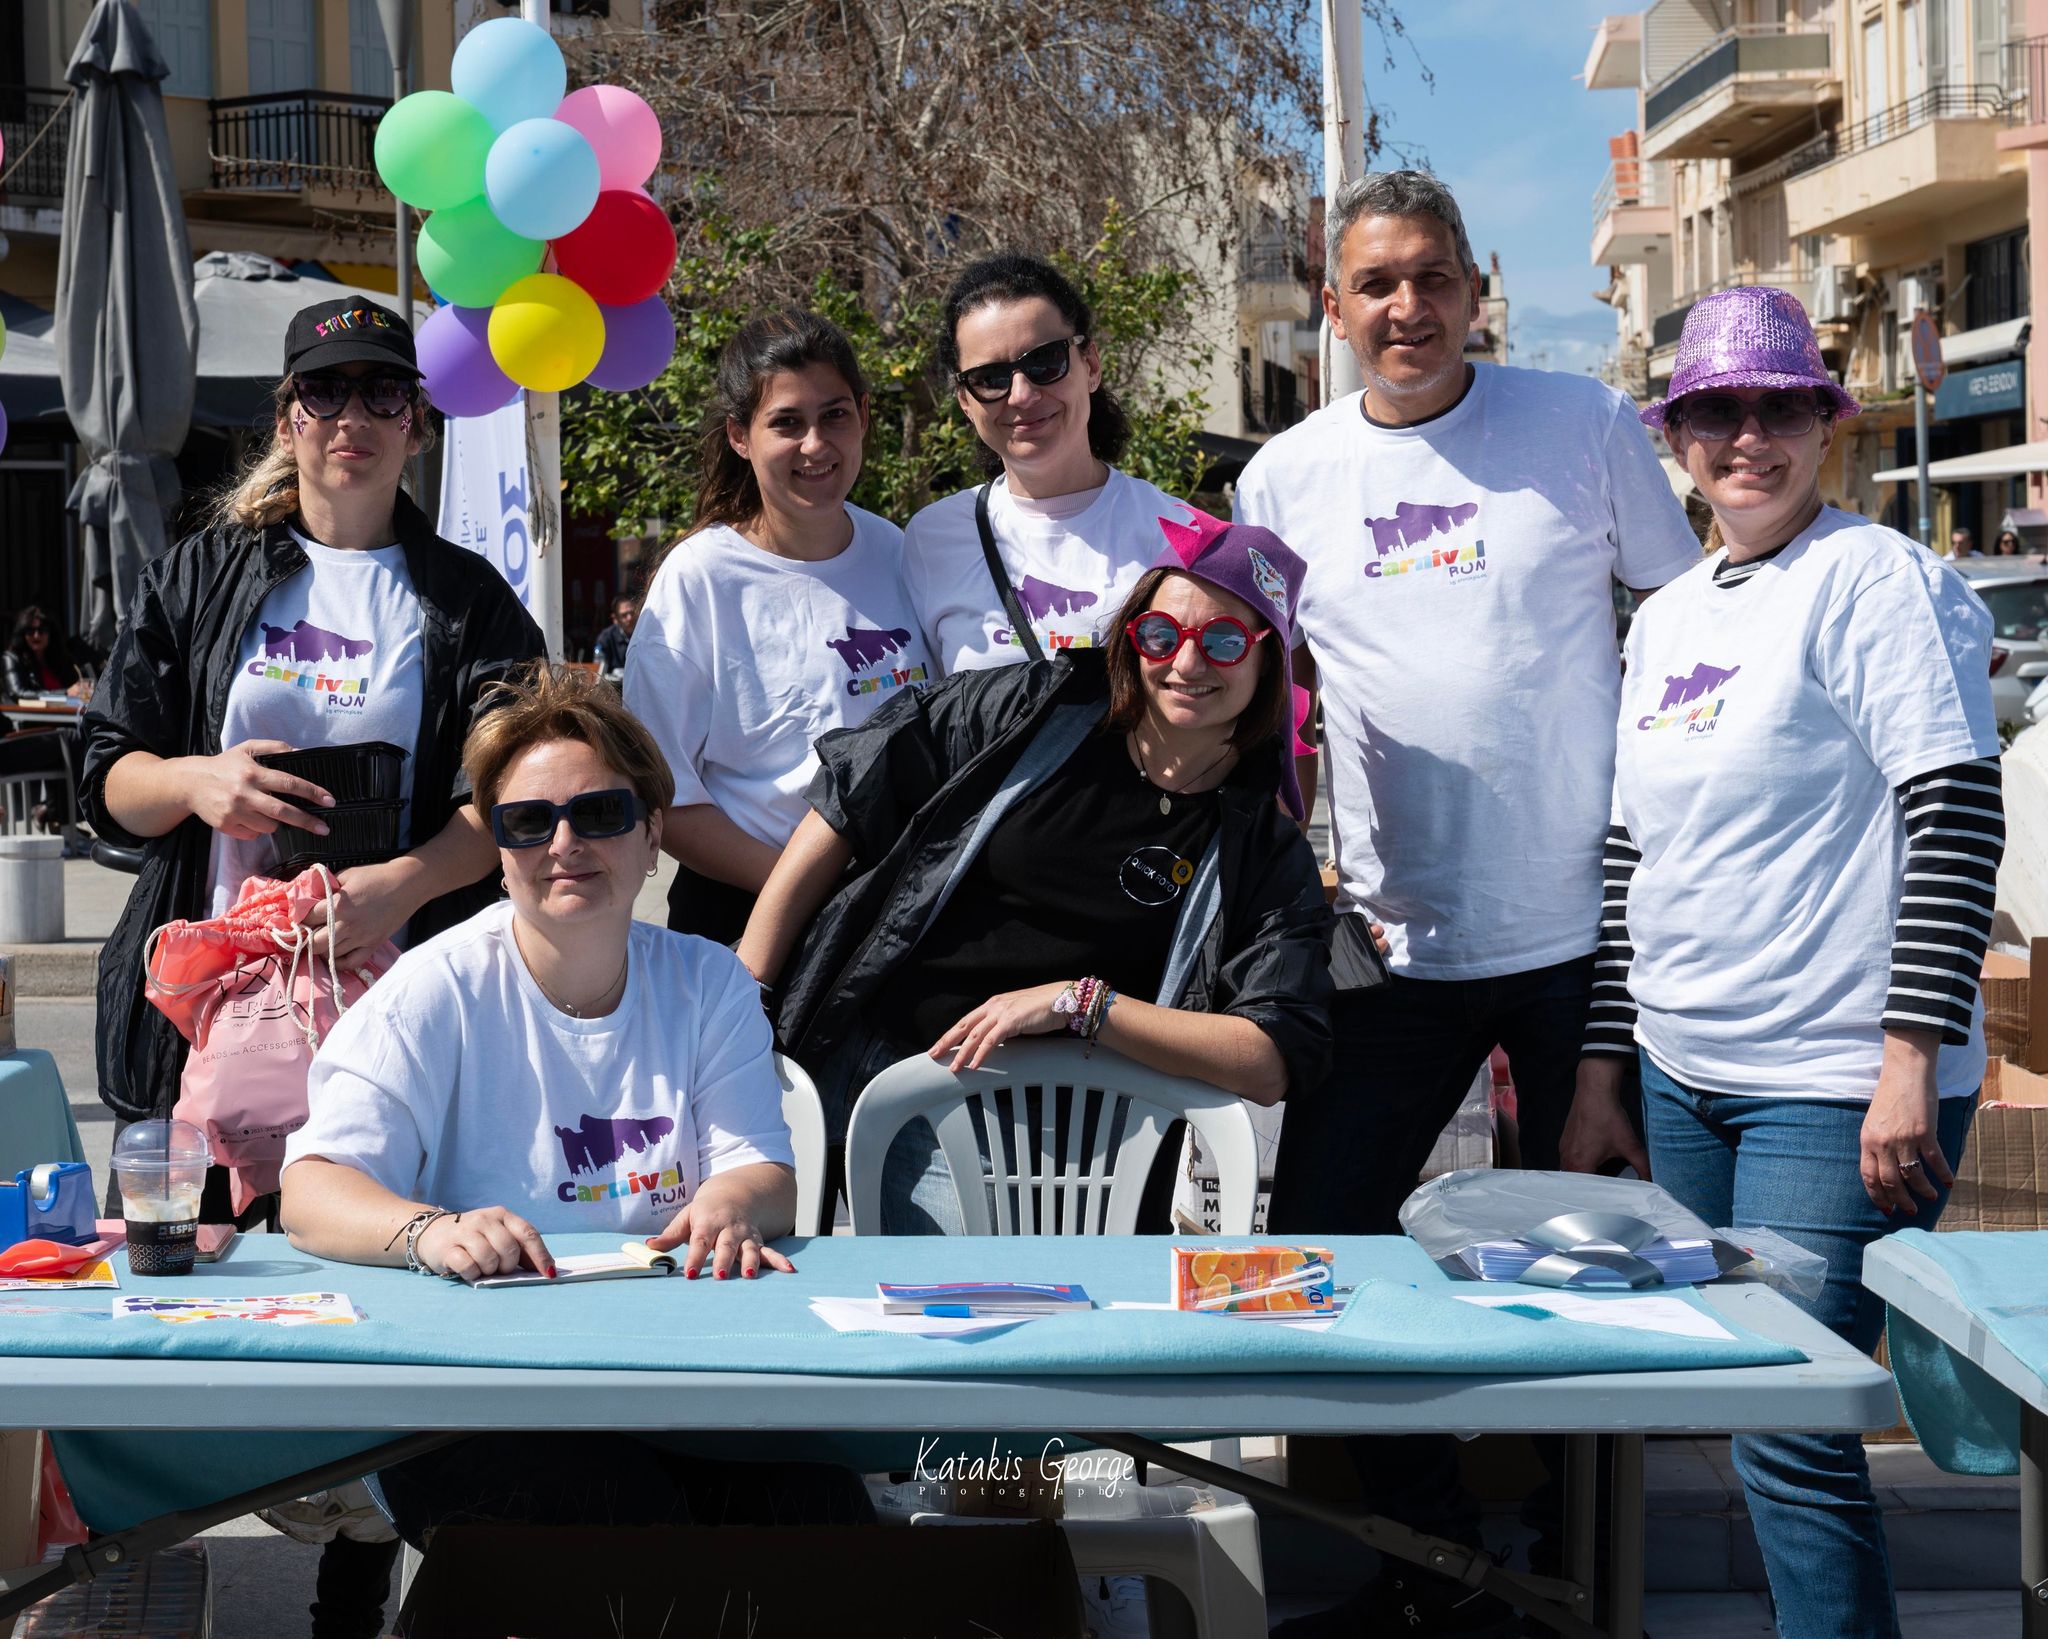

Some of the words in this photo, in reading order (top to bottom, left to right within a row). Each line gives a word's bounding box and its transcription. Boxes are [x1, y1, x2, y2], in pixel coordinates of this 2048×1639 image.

[1364, 540, 1485, 577] Carnival
[1449, 559, 1486, 577] RUN
[248, 661, 369, 694] Carnival
[847, 662, 928, 696] Carnival
[328, 694, 365, 707] RUN
[1688, 719, 1717, 733] RUN
[202, 1050, 228, 1064] BEADS
[242, 1037, 307, 1055] ACCESSORIES
[557, 1161, 684, 1202] Carnival
[651, 1185, 686, 1206] RUN
